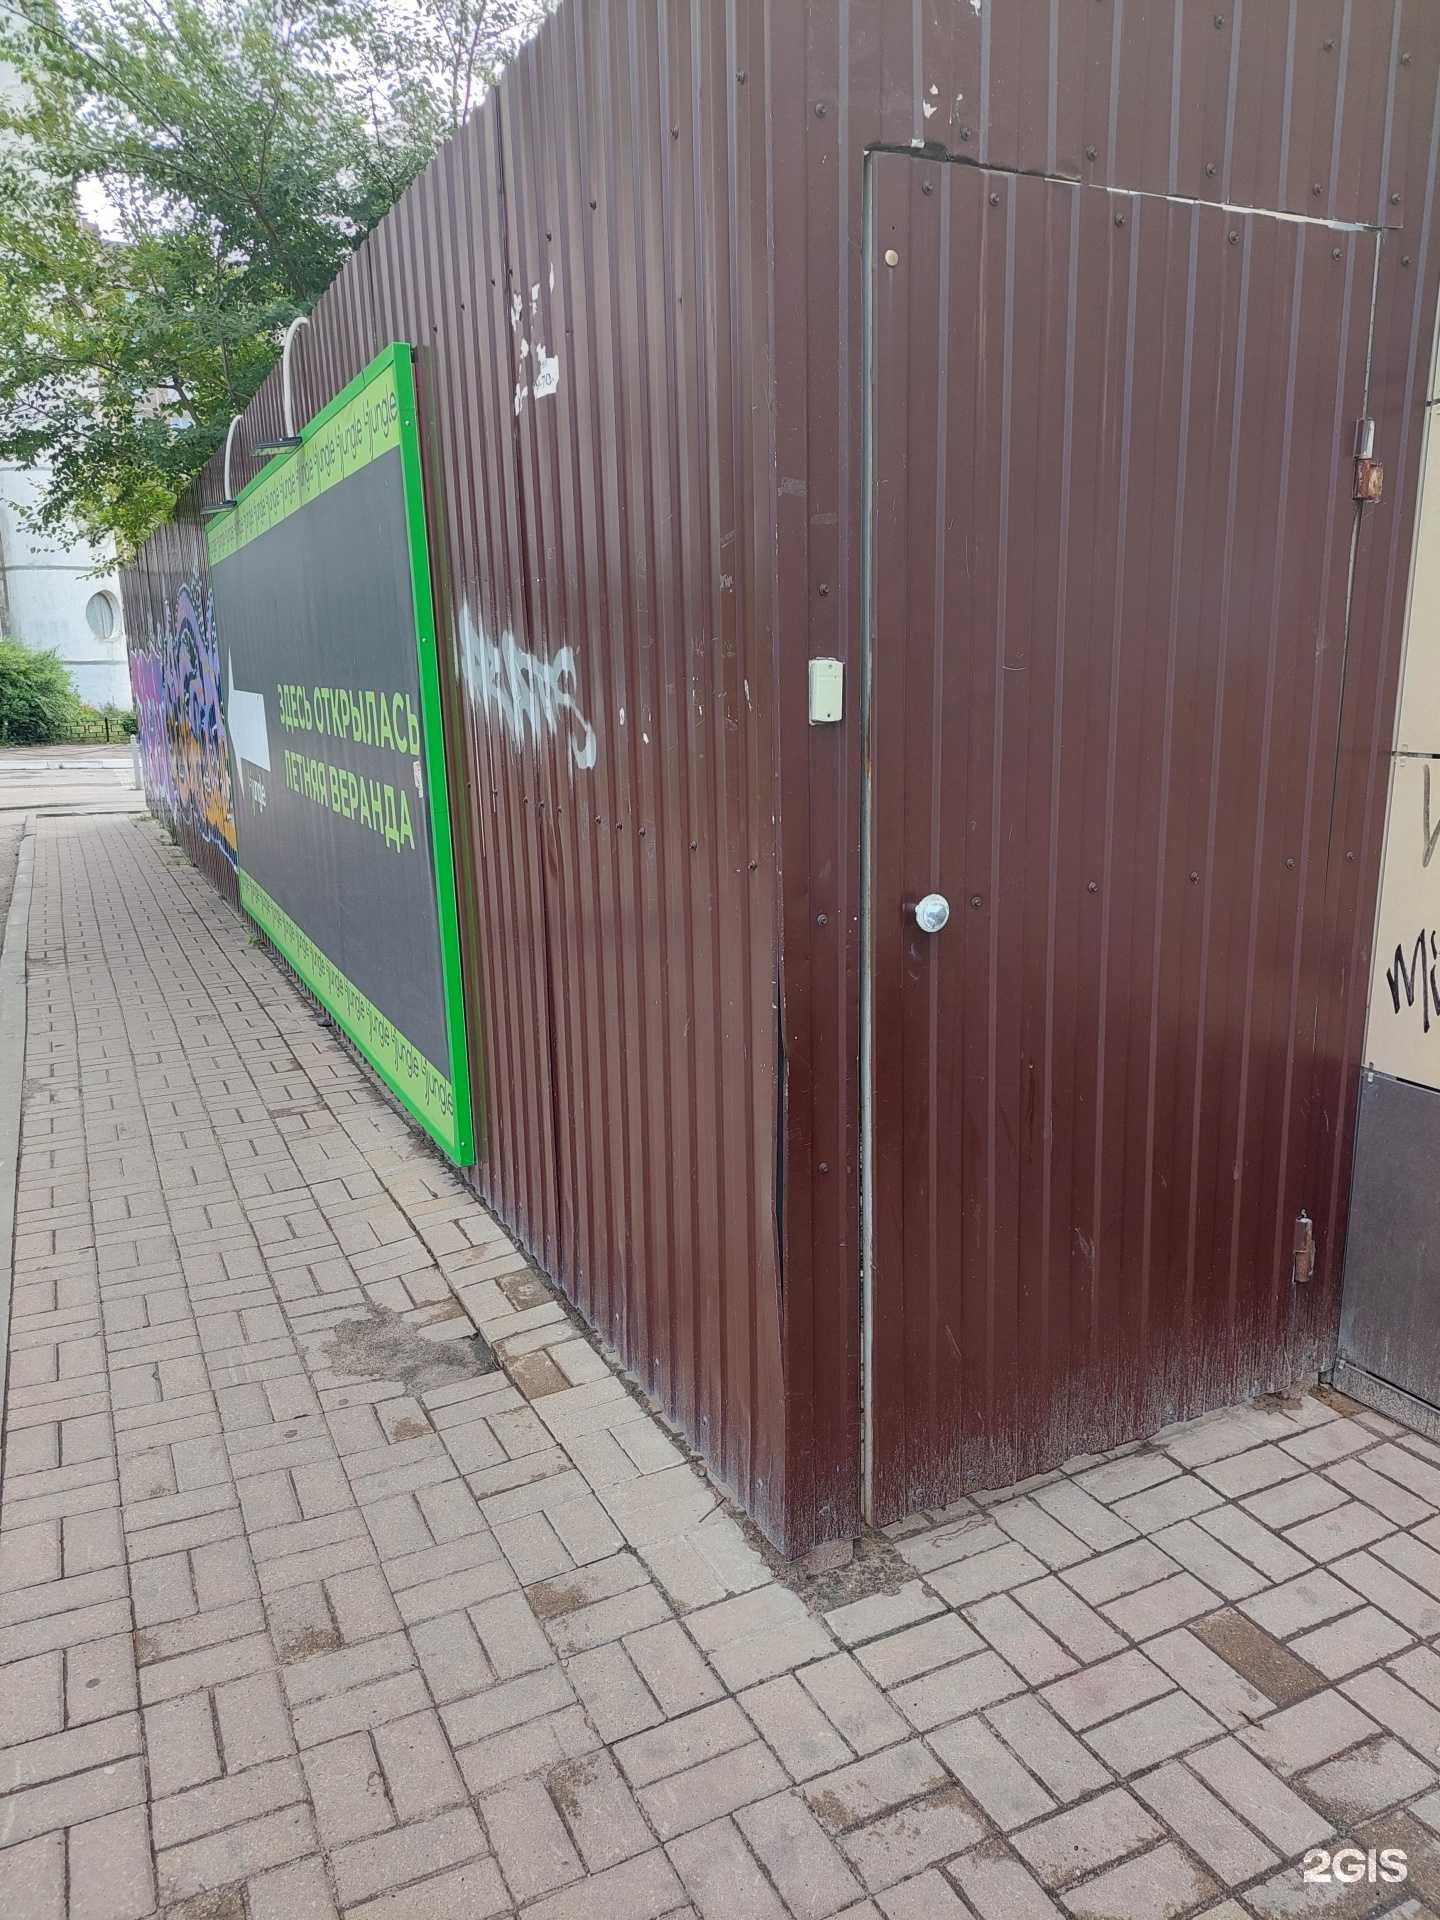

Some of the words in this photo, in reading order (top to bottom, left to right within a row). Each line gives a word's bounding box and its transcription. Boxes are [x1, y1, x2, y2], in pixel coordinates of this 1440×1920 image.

[338, 412, 362, 480] jungle
[367, 384, 398, 461] jungle
[277, 683, 313, 735] ЗДЕСЬ
[313, 686, 420, 756] ОТКРЫЛАСЬ
[284, 750, 329, 808] ЛЕТНЯЯ
[329, 766, 416, 854] ВЕРАНДА
[425, 1061, 454, 1116] jungle
